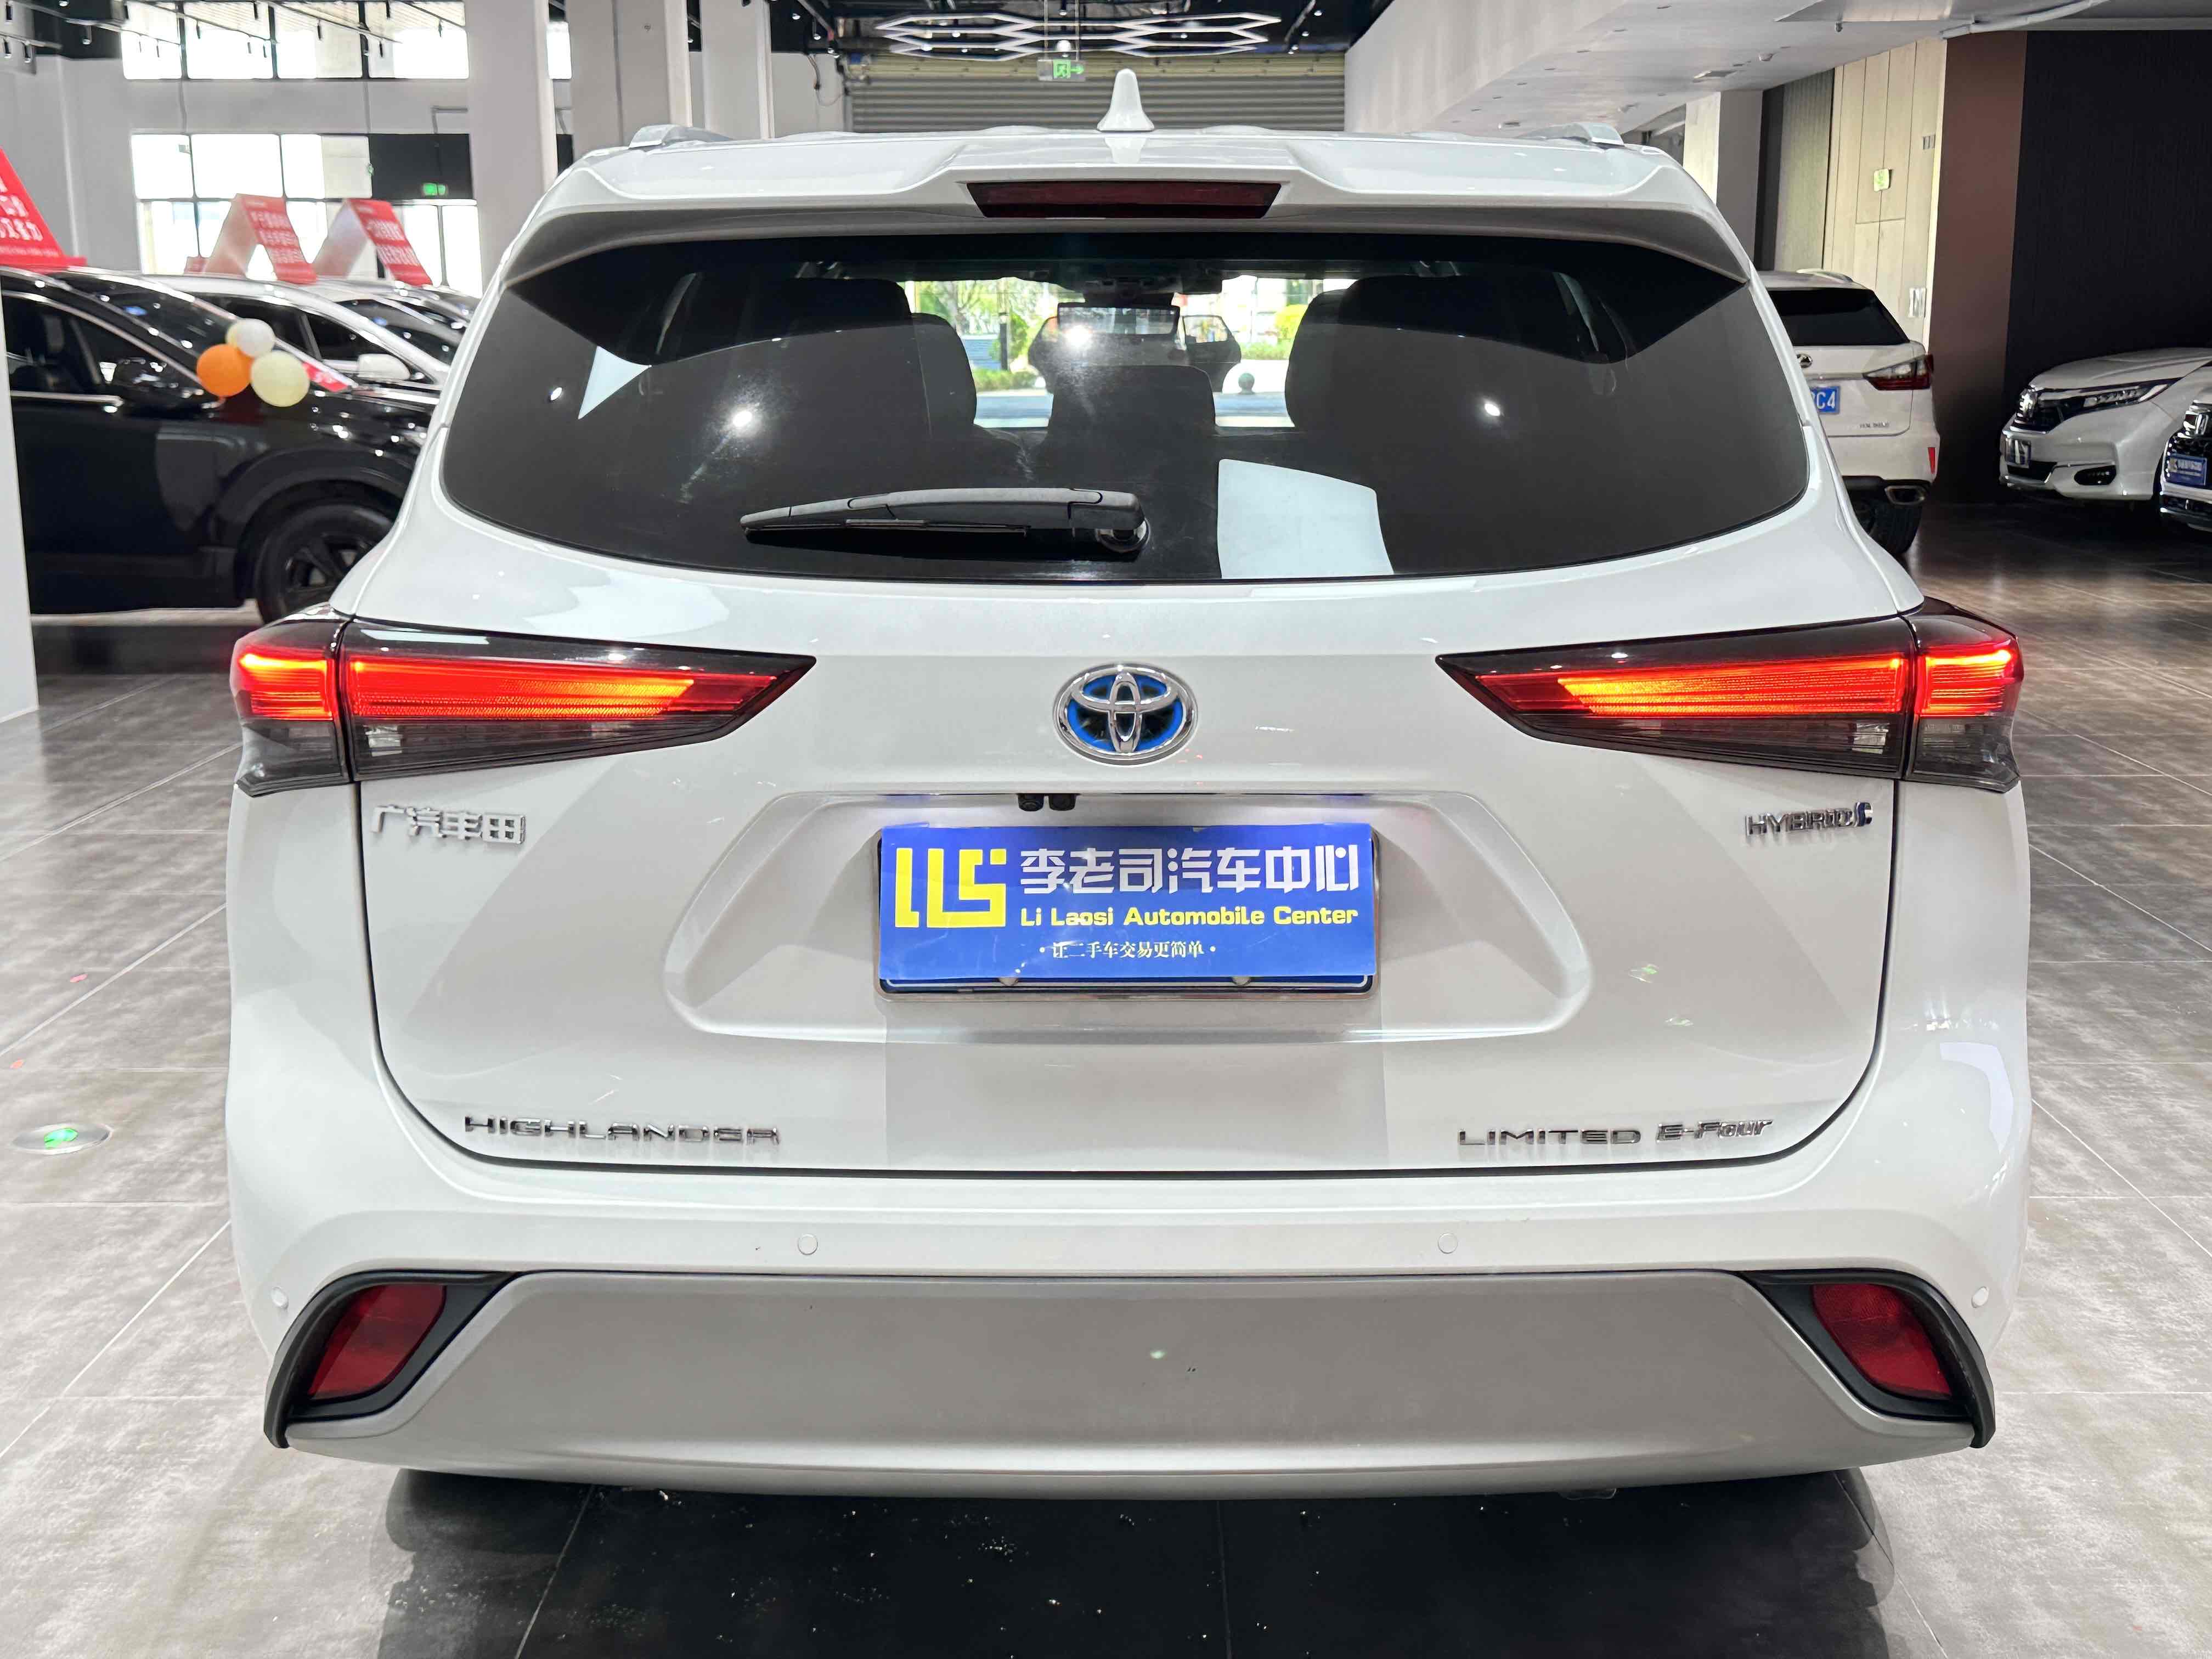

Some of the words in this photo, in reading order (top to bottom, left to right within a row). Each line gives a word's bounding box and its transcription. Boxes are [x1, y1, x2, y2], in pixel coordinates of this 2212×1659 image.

[371, 805, 526, 844] 广汽丰田
[1745, 808, 1853, 836] HYBRID
[1020, 844, 1359, 894] 李老司汽车中心
[1020, 908, 1042, 926] Li
[1051, 908, 1114, 926] Laosi
[1124, 907, 1265, 926] Automobile
[1273, 906, 1358, 926] Center
[464, 1115, 781, 1146] HIGHLANDER
[1458, 1128, 1641, 1146] LIMITED
[1655, 1118, 1774, 1142] E-Four
